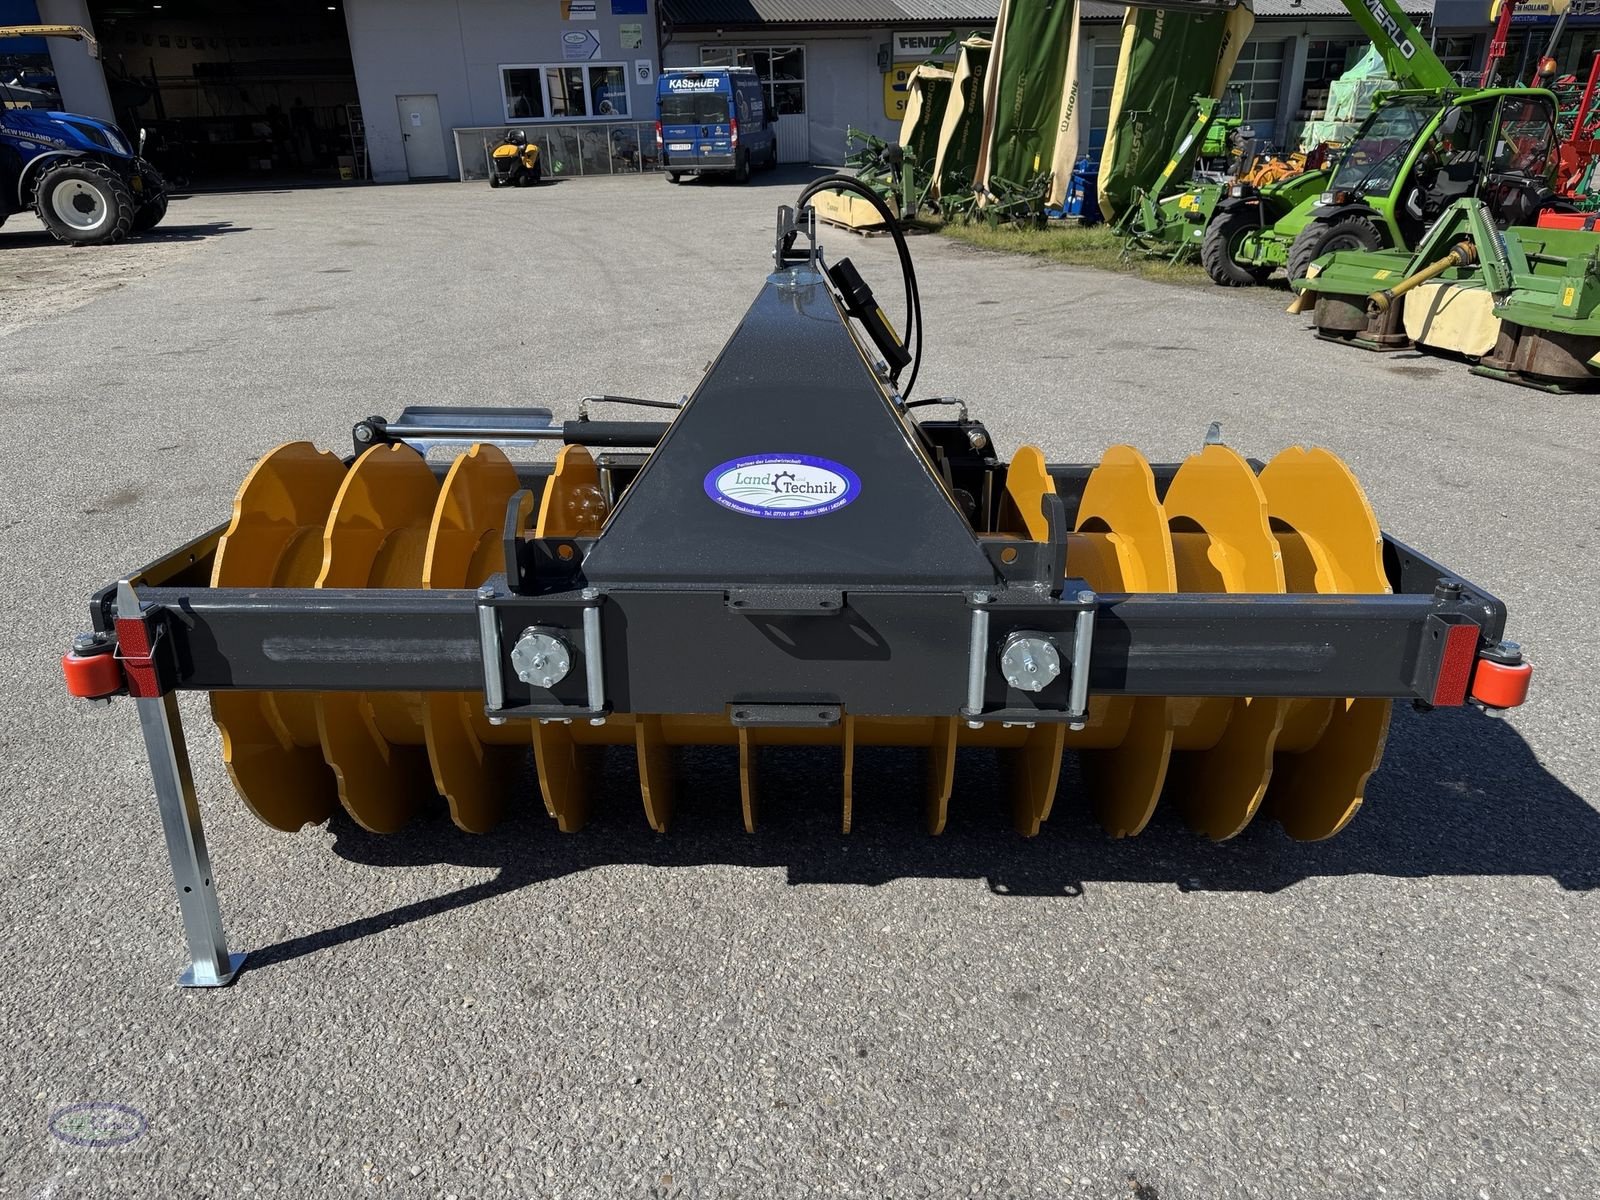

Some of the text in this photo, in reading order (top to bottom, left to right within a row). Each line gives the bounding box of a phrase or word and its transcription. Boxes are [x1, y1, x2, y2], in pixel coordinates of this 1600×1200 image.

[1523, 3, 1549, 11] HOLLAND
[1153, 8, 1165, 40] ONE
[1365, 0, 1416, 59] MERLO
[1217, 28, 1232, 64] ONE
[669, 78, 720, 89] KASBAUER
[1065, 80, 1079, 122] KRONE
[18, 130, 51, 142] HOLLAND
[735, 472, 771, 485] Land
[783, 481, 837, 494] Technik
